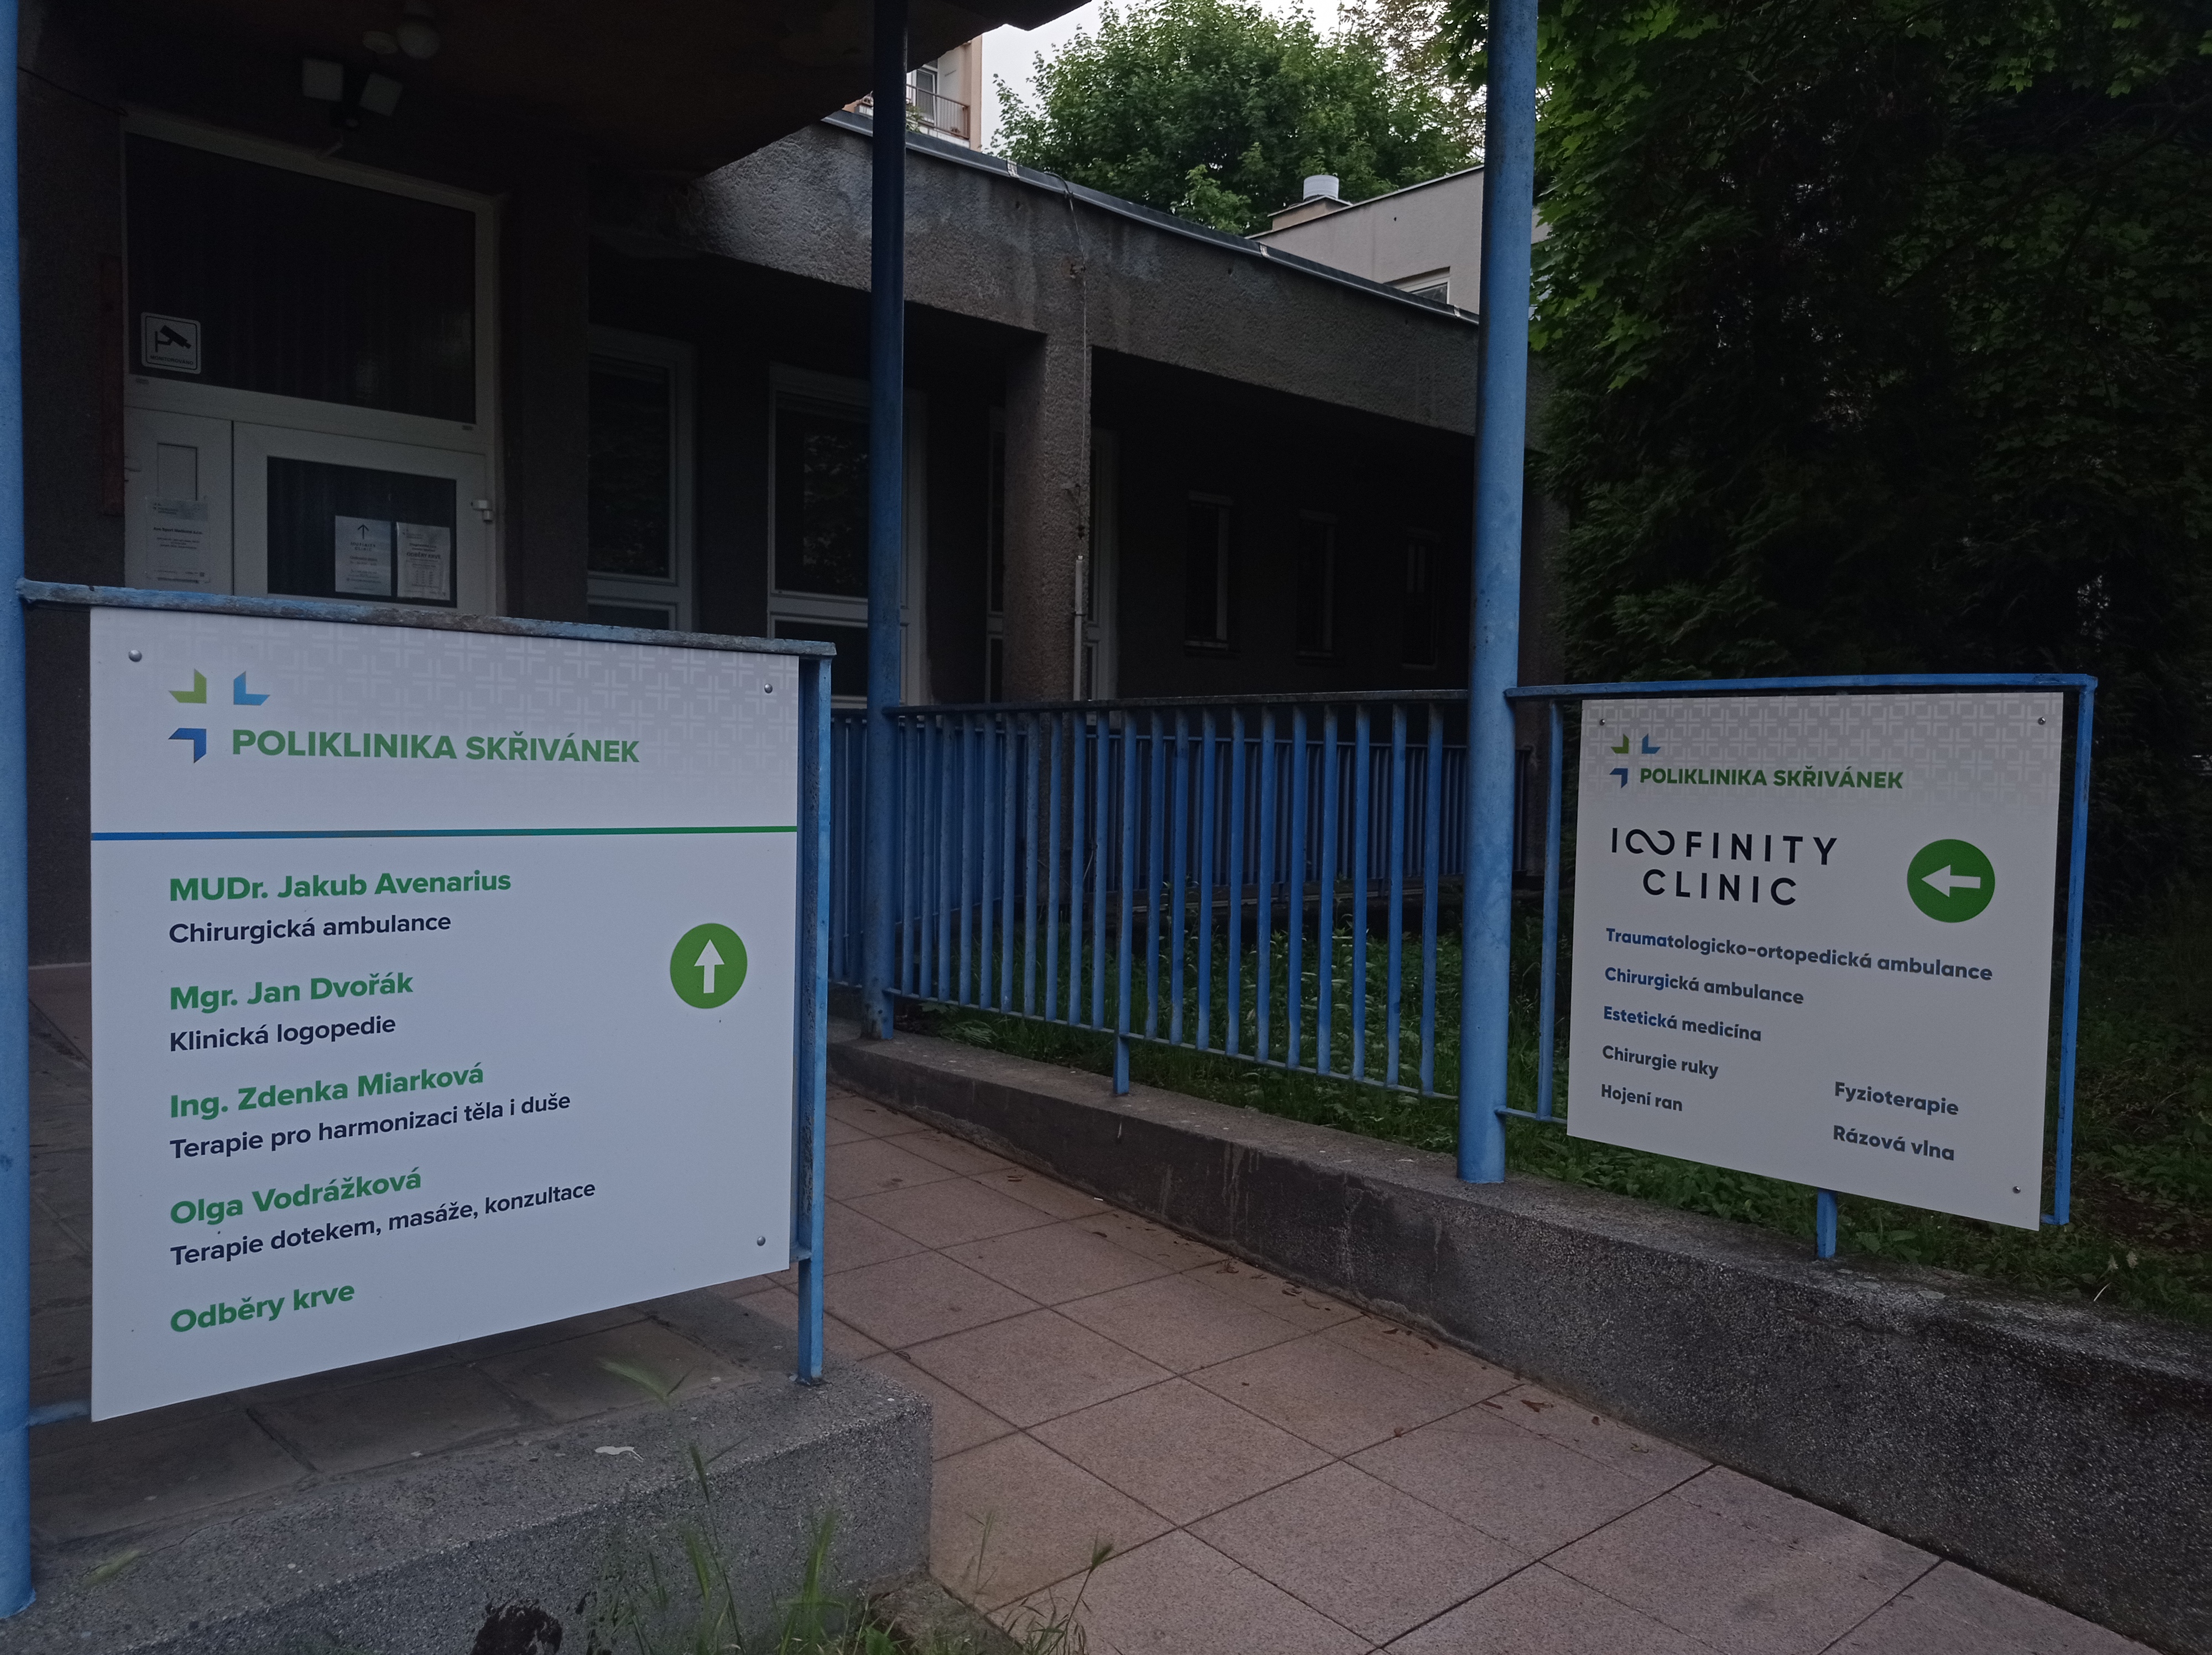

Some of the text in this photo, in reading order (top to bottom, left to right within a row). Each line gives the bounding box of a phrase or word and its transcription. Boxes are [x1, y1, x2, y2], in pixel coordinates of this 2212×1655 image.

[150, 355, 194, 365] MONITOROVÁNO
[233, 730, 639, 762] POLIKLINIKA SKŘIVÁNEK
[1640, 766, 1903, 789] POLIKLINIKA SKŘIVÁNEK
[170, 870, 511, 901] MUDr. Jakub Avenarius
[1643, 869, 1796, 905] CLINIC
[169, 914, 451, 944] Chirurgická ambulance
[1606, 928, 1992, 981] Traumatologicko-ortopedická ambulance
[170, 972, 413, 1014] Mgr. Jan Dvořák
[1605, 967, 1804, 1005] Chirurgická ambulance
[170, 1016, 395, 1052] Klinická logopedie
[1604, 1006, 1761, 1042] Estetická medicína
[1603, 1045, 1719, 1079] Chirurgie ruky
[171, 1062, 483, 1120] Ing. Zdenka Miarková
[1601, 1084, 1682, 1111] Hojení ran
[1835, 1081, 1959, 1115] Fyzioterapie
[170, 1092, 570, 1158] Terapie pro harmonizaci těla i duše
[1834, 1125, 1954, 1160] Rázová vlna
[170, 1167, 421, 1225] Olga Vodrážková
[170, 1184, 596, 1265] Terapie dotekem, masáže, konzultace
[170, 1286, 354, 1333] Odběry krve
